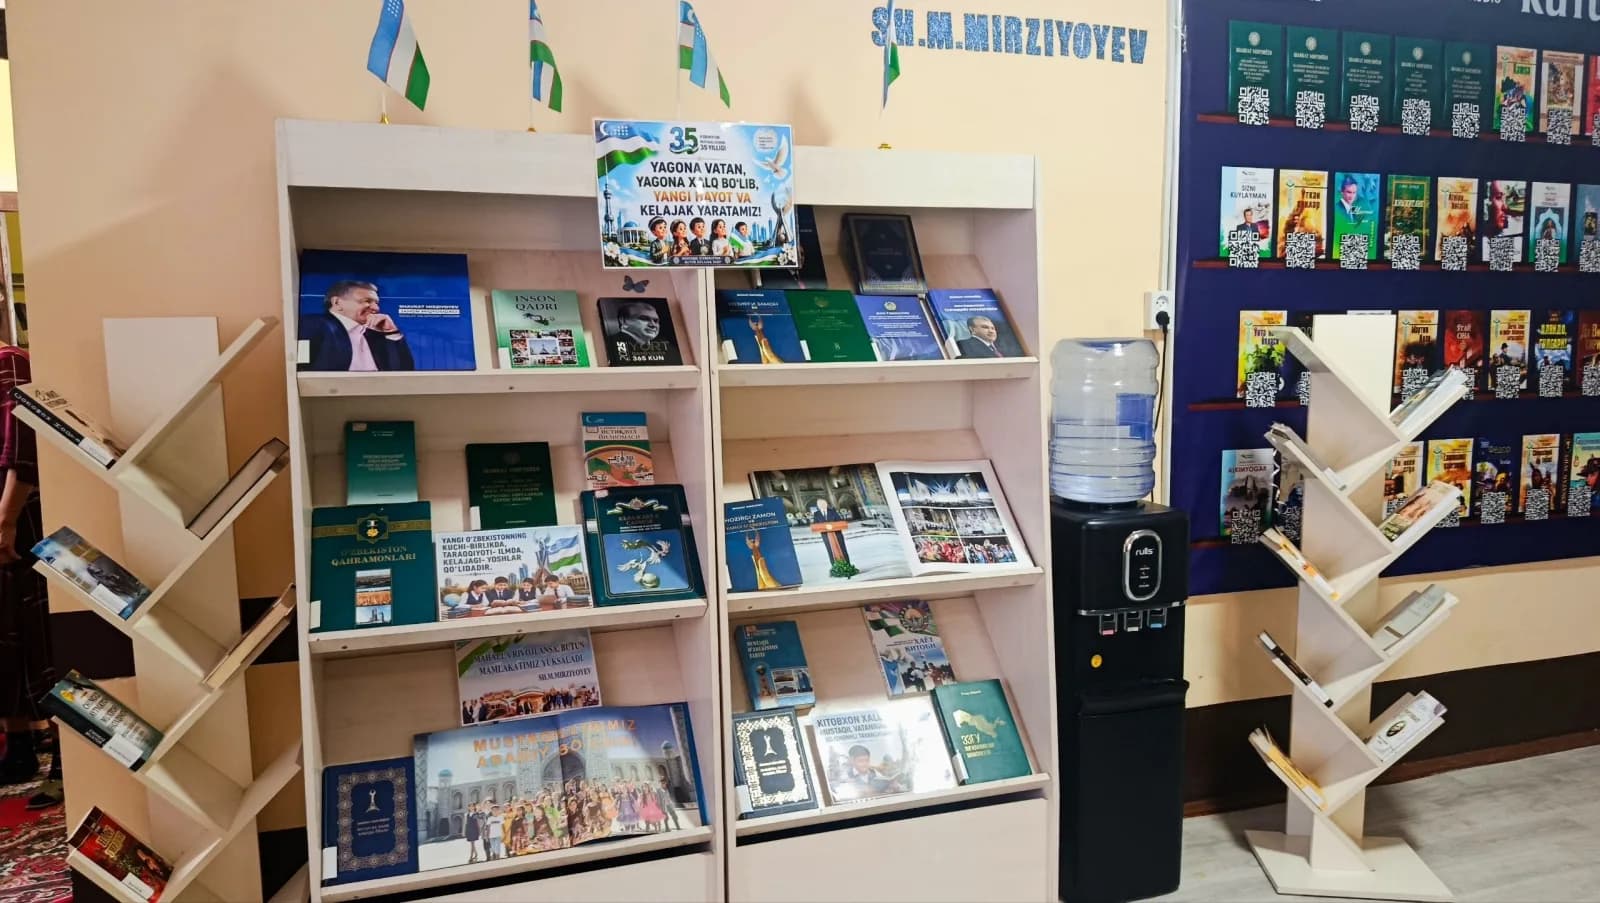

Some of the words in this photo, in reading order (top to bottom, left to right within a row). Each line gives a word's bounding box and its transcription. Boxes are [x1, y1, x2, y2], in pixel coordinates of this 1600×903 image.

[871, 6, 1148, 64] SH.M.MIRZIYOYEV
[669, 126, 699, 153] 35
[651, 161, 700, 174] YAGONA
[704, 163, 746, 176] VATAN,
[636, 176, 685, 188] YAGONA
[653, 191, 691, 202] YANGI
[736, 192, 752, 203] VA
[640, 205, 694, 216] KELAJAK
[697, 206, 761, 217] YARATAMIZ!
[752, 512, 776, 520] ZAMON
[441, 536, 464, 544] YANGI
[465, 532, 527, 543] O'ZBEKISTONNING
[331, 553, 417, 567] QAHRAMONLARI
[486, 554, 522, 563] YOSHLAR
[561, 641, 585, 652] BUTUN
[479, 661, 539, 675] MAMLAKATIMIZ
[817, 715, 861, 728] KITOBXON
